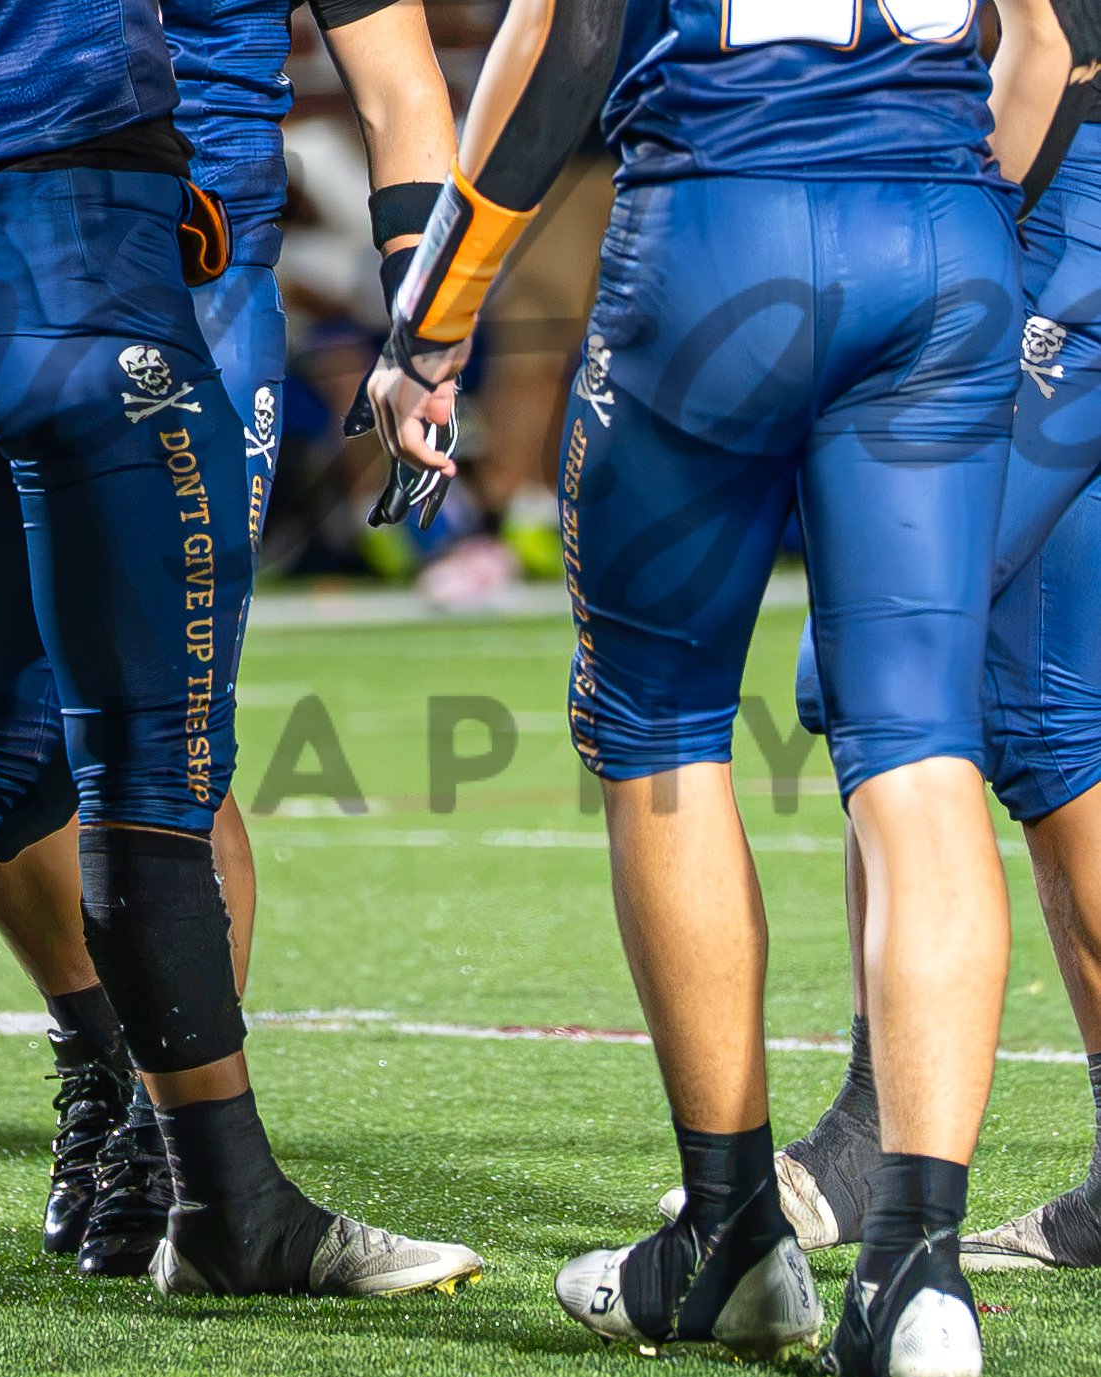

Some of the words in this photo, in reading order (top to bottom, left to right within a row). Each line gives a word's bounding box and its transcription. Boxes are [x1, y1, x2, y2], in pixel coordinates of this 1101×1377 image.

[158, 428, 211, 525] DON'T
[563, 417, 588, 502] SHIP
[183, 532, 214, 611] GIVE
[185, 616, 213, 663] UP
[185, 668, 213, 734] THE
